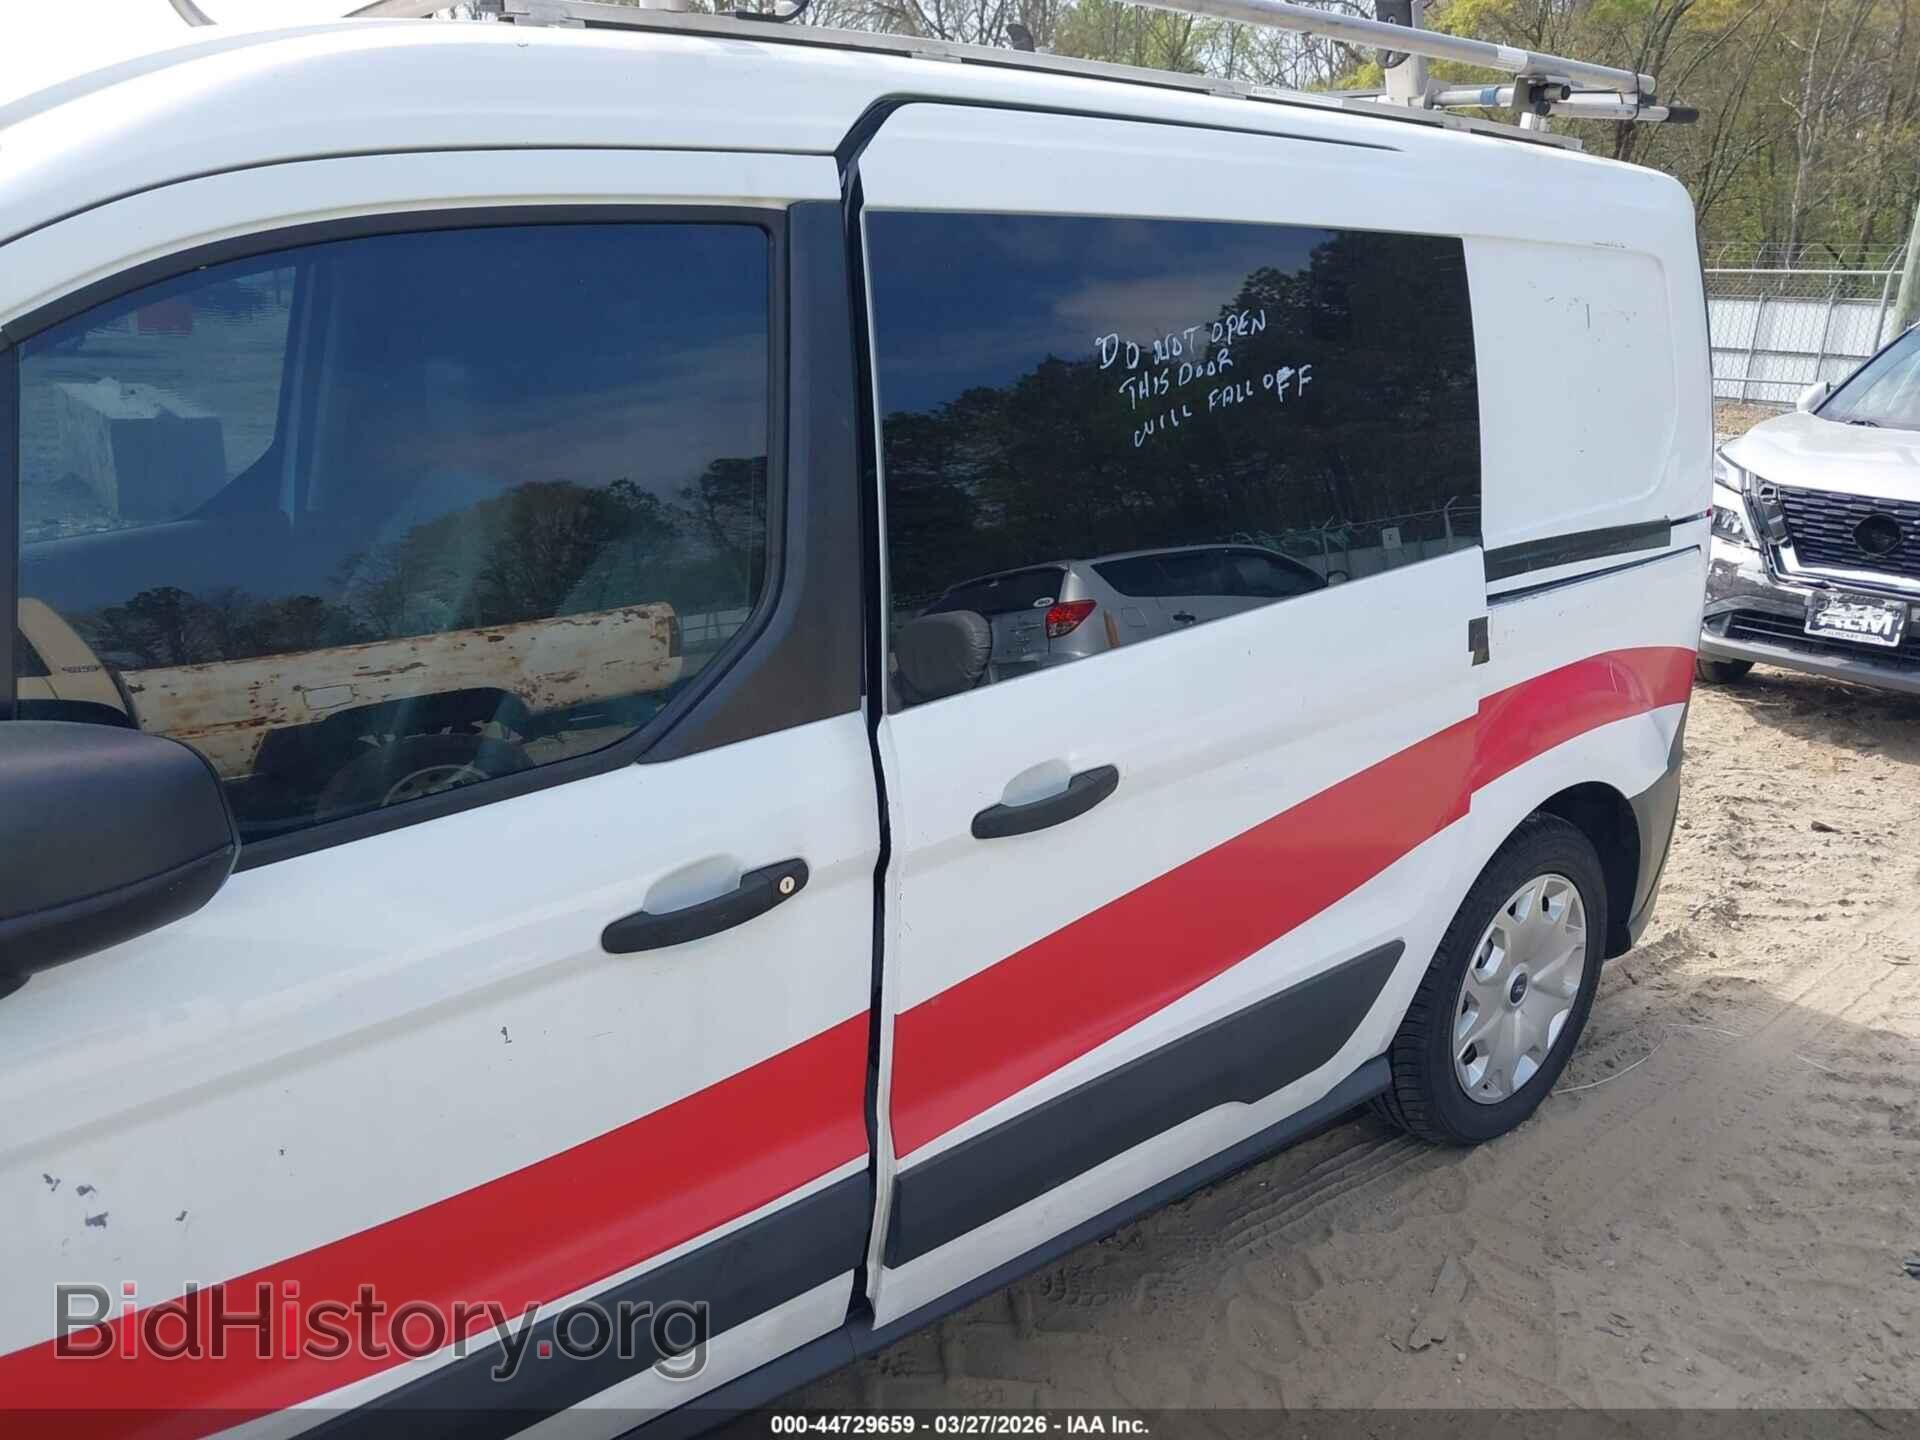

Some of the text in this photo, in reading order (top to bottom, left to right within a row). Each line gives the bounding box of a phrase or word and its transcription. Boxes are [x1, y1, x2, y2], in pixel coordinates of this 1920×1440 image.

[1095, 309, 1266, 369] DO NOT OPEN
[1119, 348, 1233, 410] THIS DOOR
[1134, 364, 1312, 448] WILL FALL OFF
